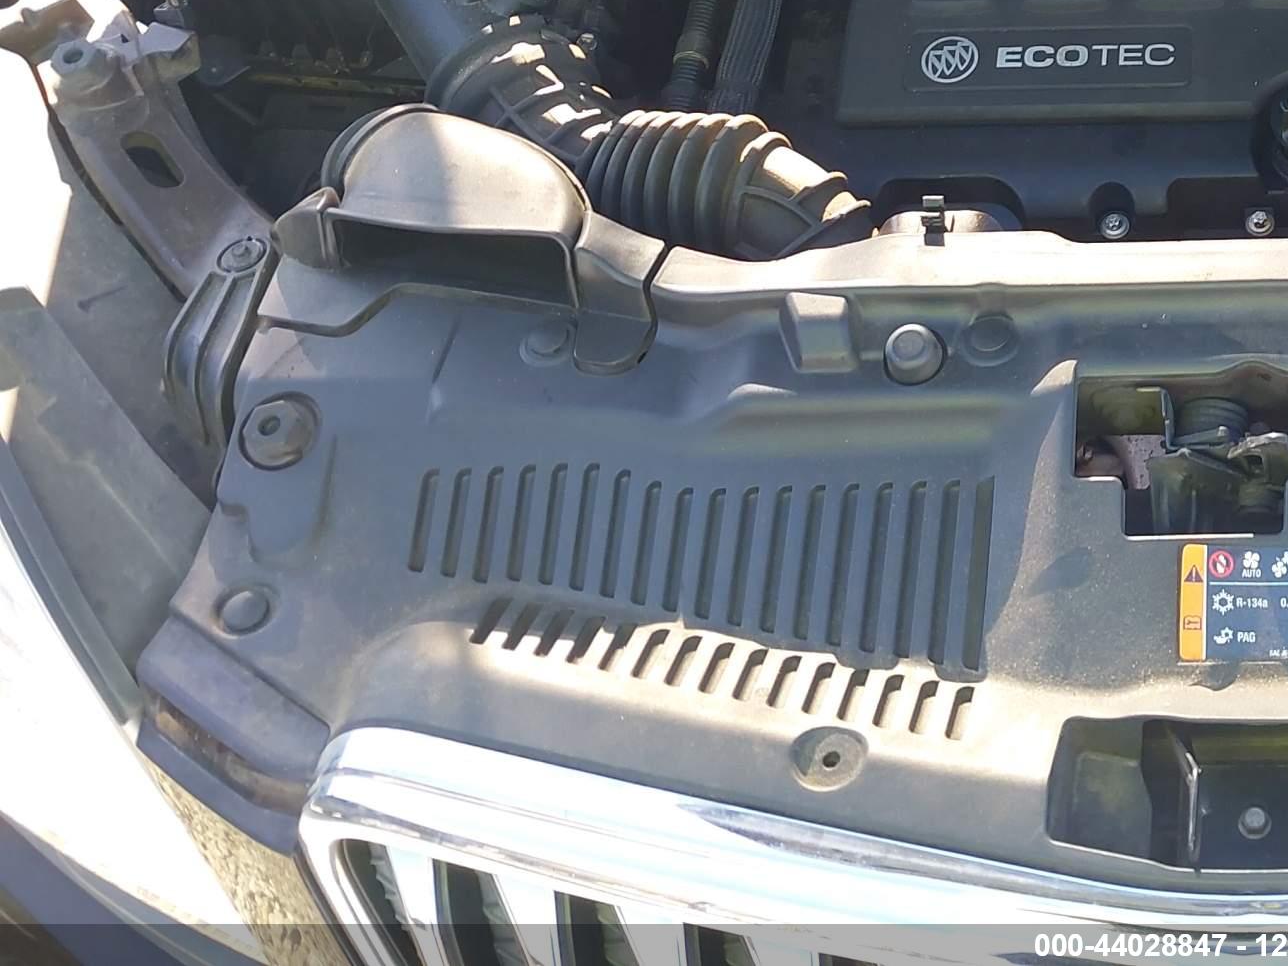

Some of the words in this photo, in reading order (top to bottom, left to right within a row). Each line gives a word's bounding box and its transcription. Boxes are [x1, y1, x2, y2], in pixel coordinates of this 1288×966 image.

[996, 43, 1175, 68] ECOTEC
[1242, 569, 1261, 578] AUTO
[1236, 597, 1268, 608] R-134a
[1237, 631, 1256, 643] PAG
